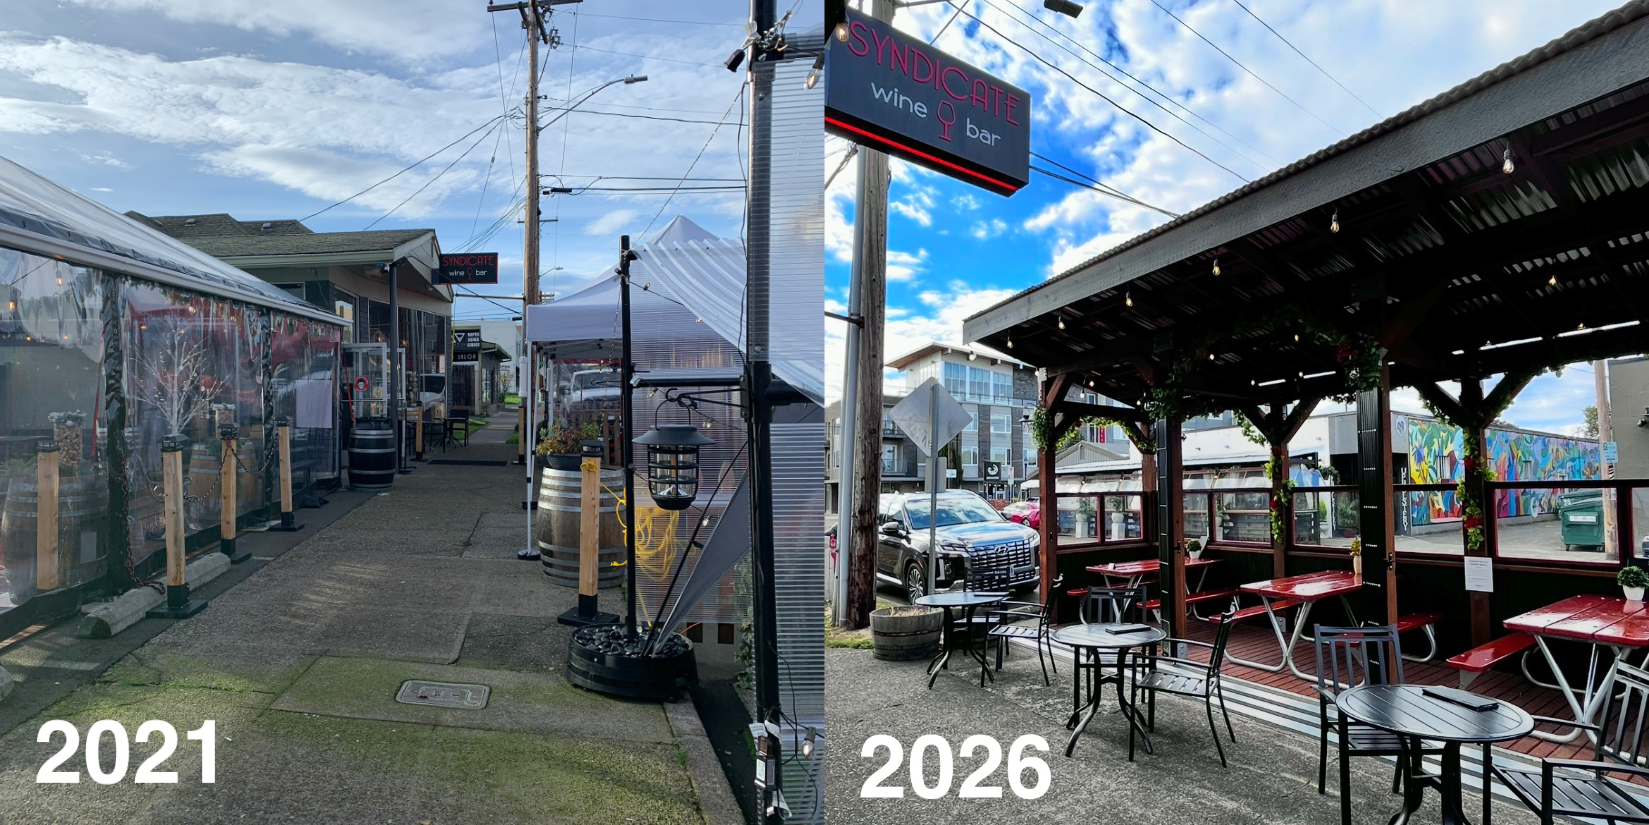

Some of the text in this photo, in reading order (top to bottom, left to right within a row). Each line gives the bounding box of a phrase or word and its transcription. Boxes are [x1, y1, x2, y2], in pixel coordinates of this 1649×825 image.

[848, 21, 1020, 126] SYNDICATE
[871, 82, 1002, 147] wine bar
[442, 255, 494, 267] SYNDICATE
[475, 268, 488, 276] bar
